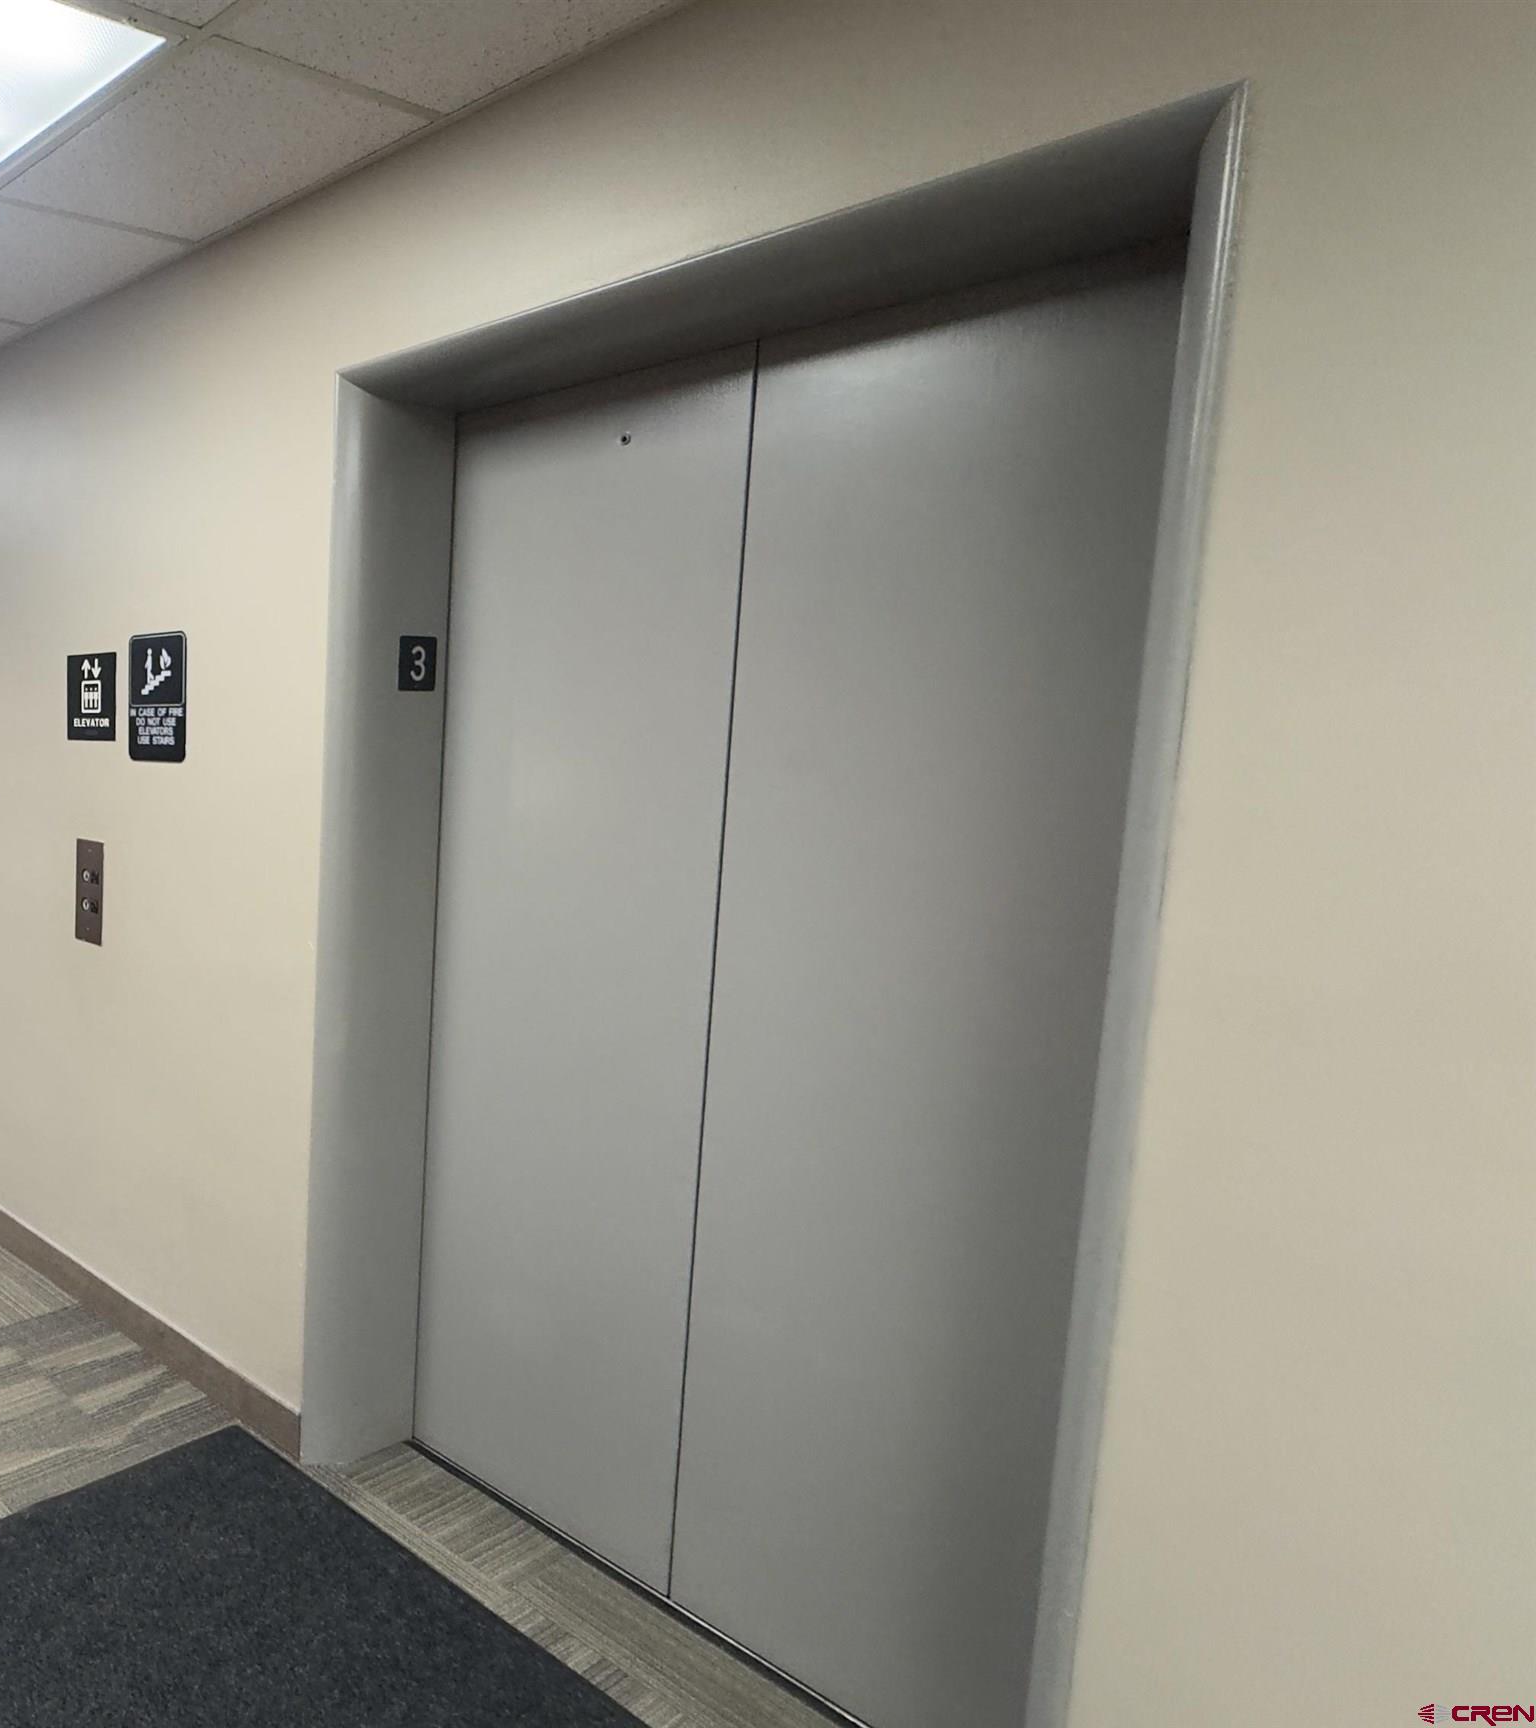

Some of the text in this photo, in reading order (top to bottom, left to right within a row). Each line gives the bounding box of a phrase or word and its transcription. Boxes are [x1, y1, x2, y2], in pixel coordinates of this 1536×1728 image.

[410, 645, 426, 681] 3
[130, 707, 184, 717] IN CASE OF FIRE
[73, 718, 110, 728] ELEVATOR
[136, 717, 176, 727] DO NOT USE
[138, 726, 173, 736] ELEVATORS
[137, 736, 175, 746] USE STAIRS
